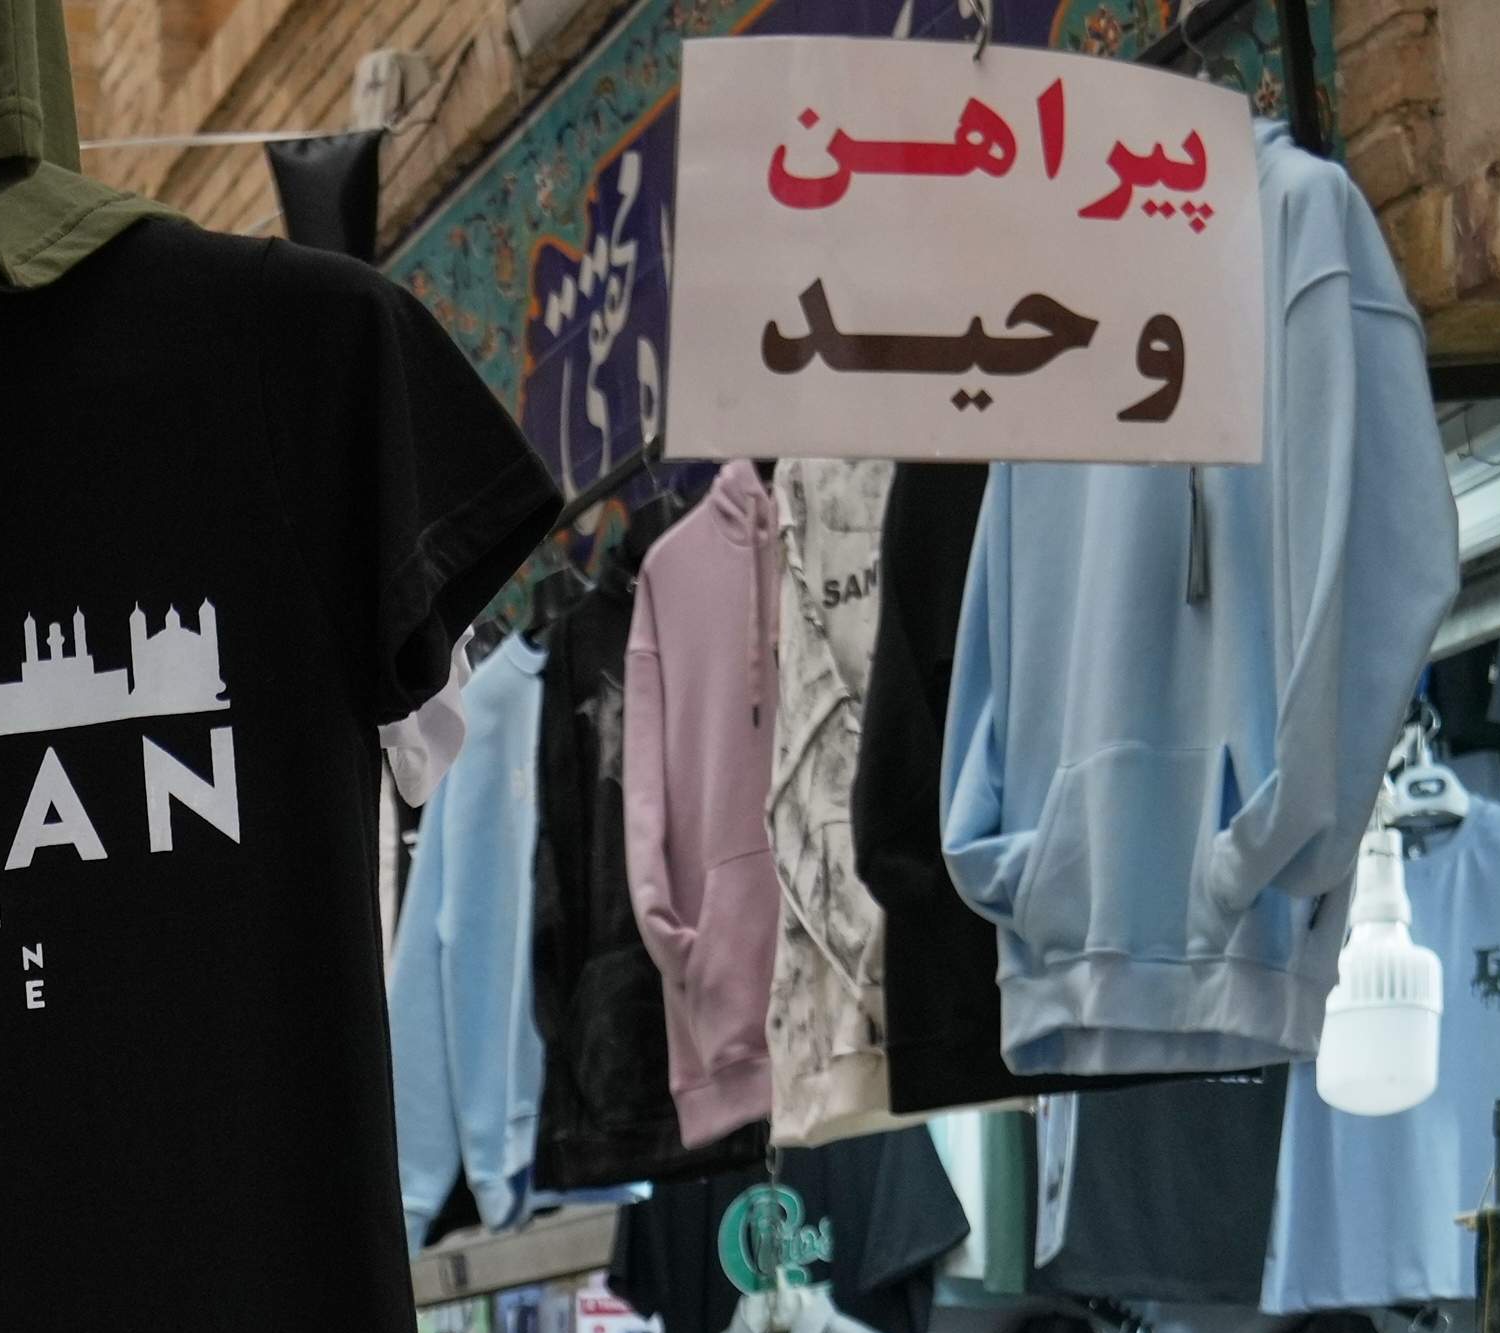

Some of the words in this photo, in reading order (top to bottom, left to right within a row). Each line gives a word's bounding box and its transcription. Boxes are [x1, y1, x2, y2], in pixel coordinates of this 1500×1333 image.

[766, 77, 1214, 234] پیراهن
[761, 277, 1186, 423] وحید
[22, 943, 45, 971] N
[26, 979, 46, 1010] E
